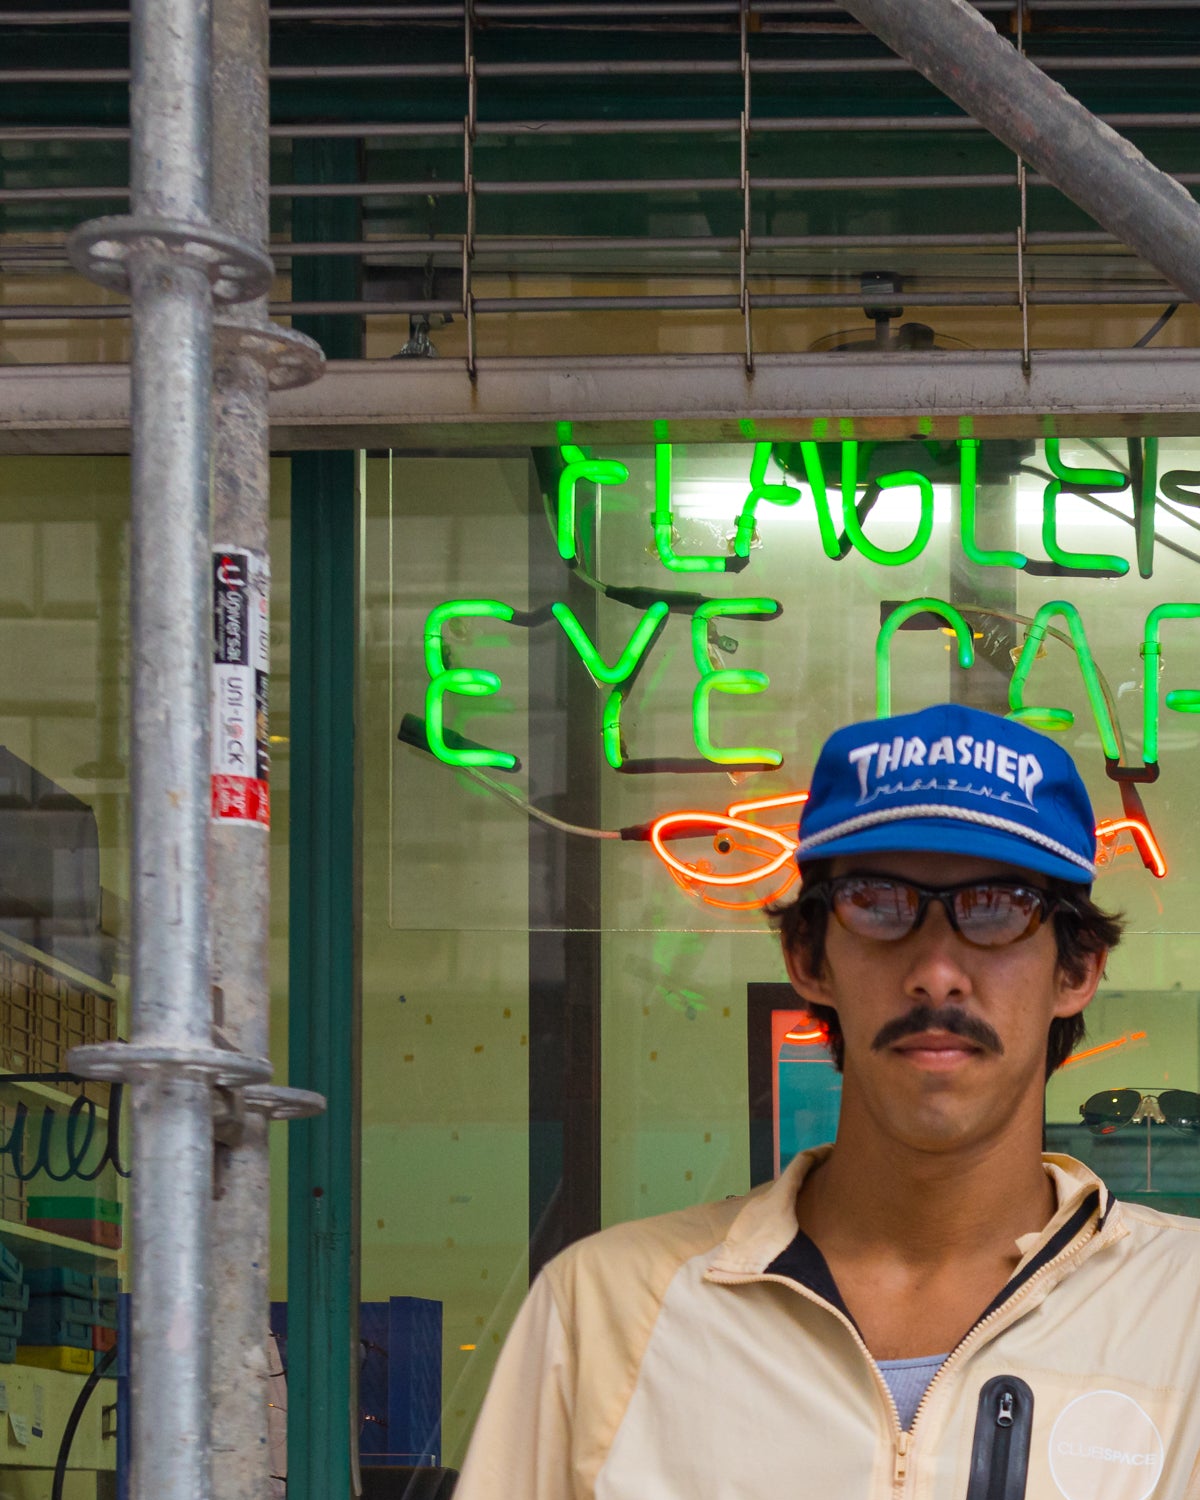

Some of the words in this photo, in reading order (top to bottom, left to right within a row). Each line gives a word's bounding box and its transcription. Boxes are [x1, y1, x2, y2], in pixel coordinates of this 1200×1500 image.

[425, 598, 784, 770] EYE
[849, 735, 1044, 806] THRASHER
[1057, 1441, 1156, 1466] CLUBSPACE
